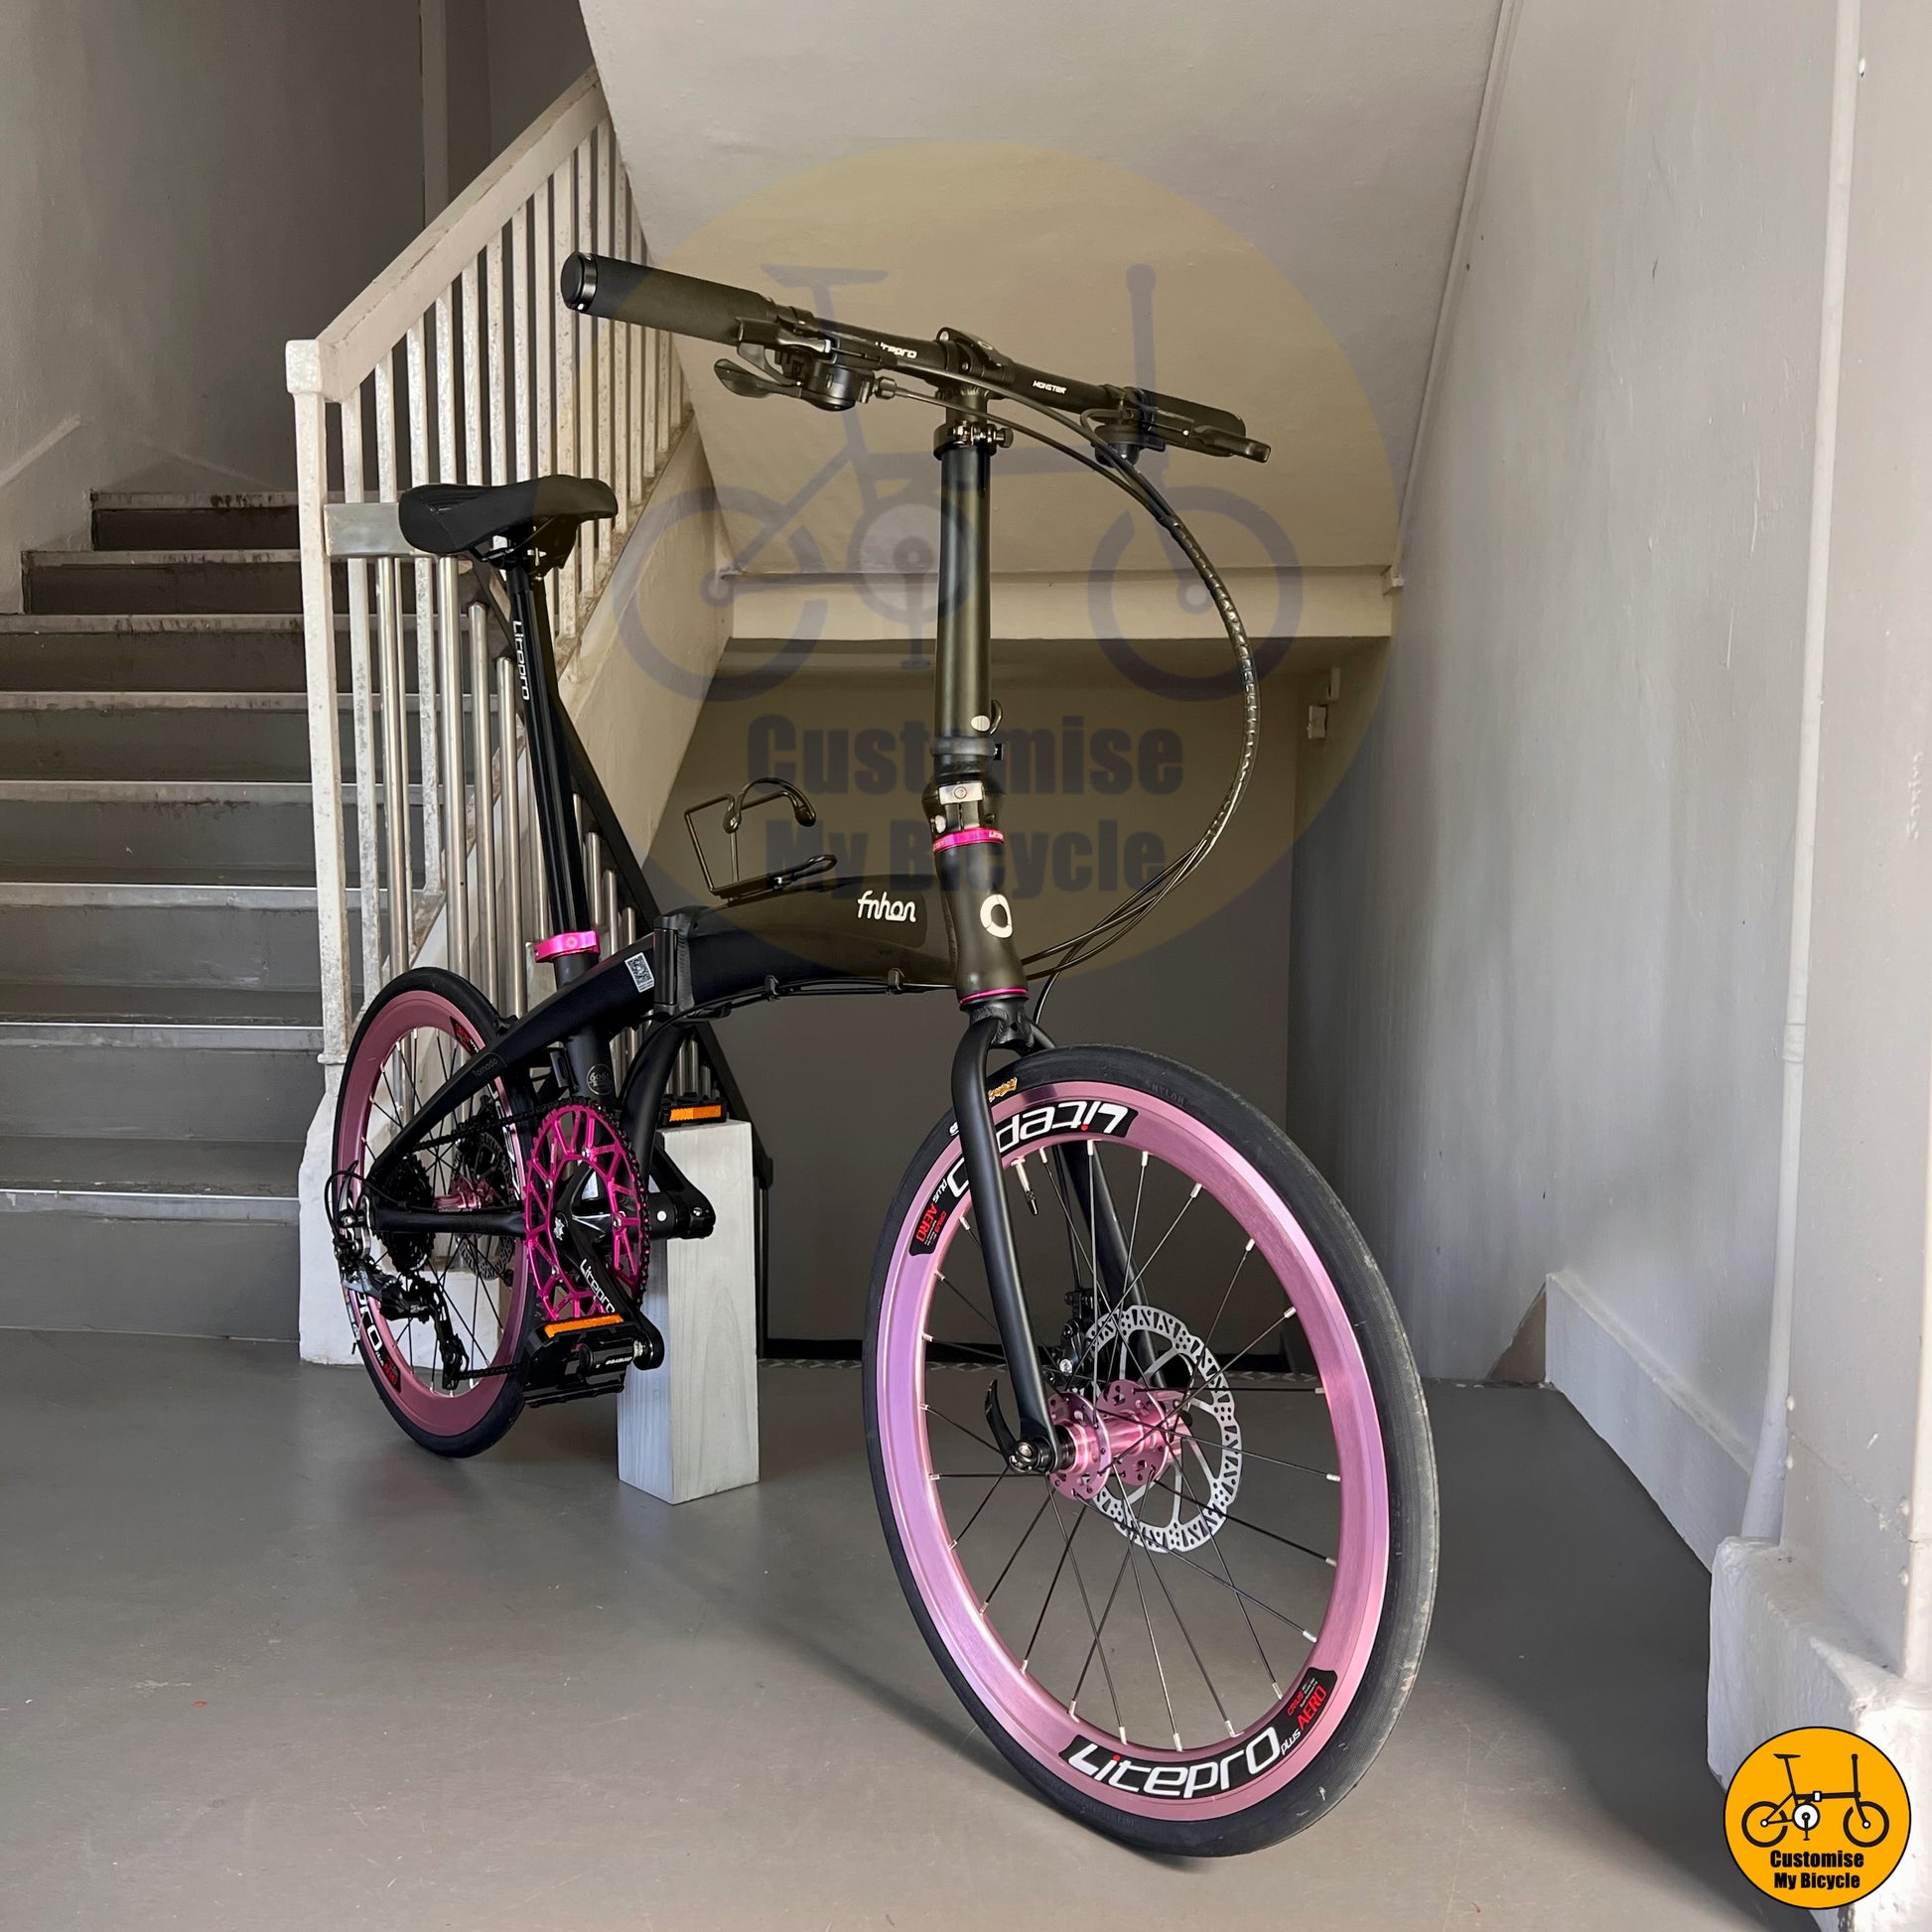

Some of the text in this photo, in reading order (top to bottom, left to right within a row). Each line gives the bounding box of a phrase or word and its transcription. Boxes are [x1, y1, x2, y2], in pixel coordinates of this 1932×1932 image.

[1033, 380, 1067, 394] MONSTER
[857, 890, 916, 922] fnhon
[946, 1100, 1129, 1198] Litepo
[932, 1177, 948, 1203] plus
[915, 1202, 938, 1242] AERO
[1068, 1725, 1281, 1799] Litepro
[1281, 1727, 1302, 1756] plus
[1297, 1685, 1327, 1731] AERO
